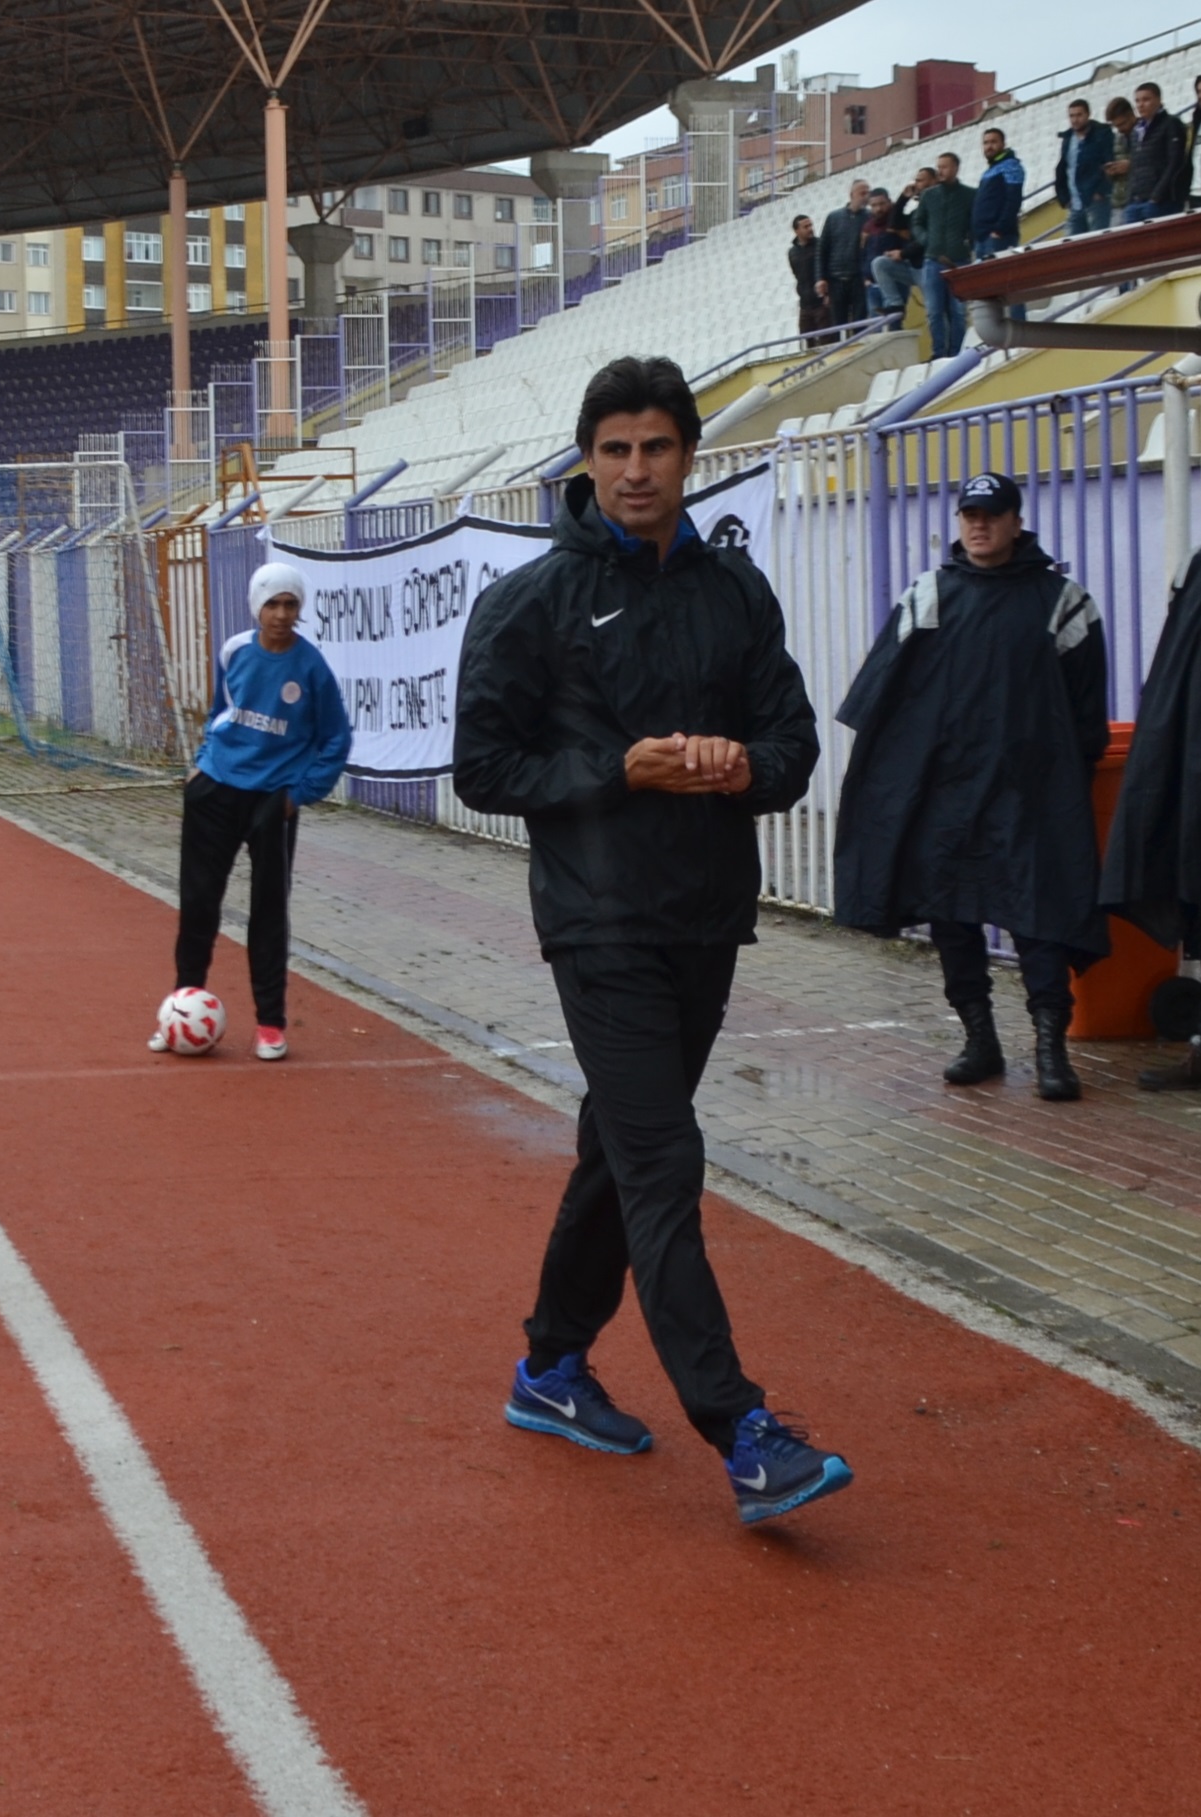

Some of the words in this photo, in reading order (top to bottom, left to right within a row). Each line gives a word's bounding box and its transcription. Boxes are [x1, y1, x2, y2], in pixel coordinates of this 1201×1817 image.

[403, 560, 470, 637] GÖRMEDEN
[340, 677, 383, 733] UPAYI
[388, 666, 449, 731] CENNETTE
